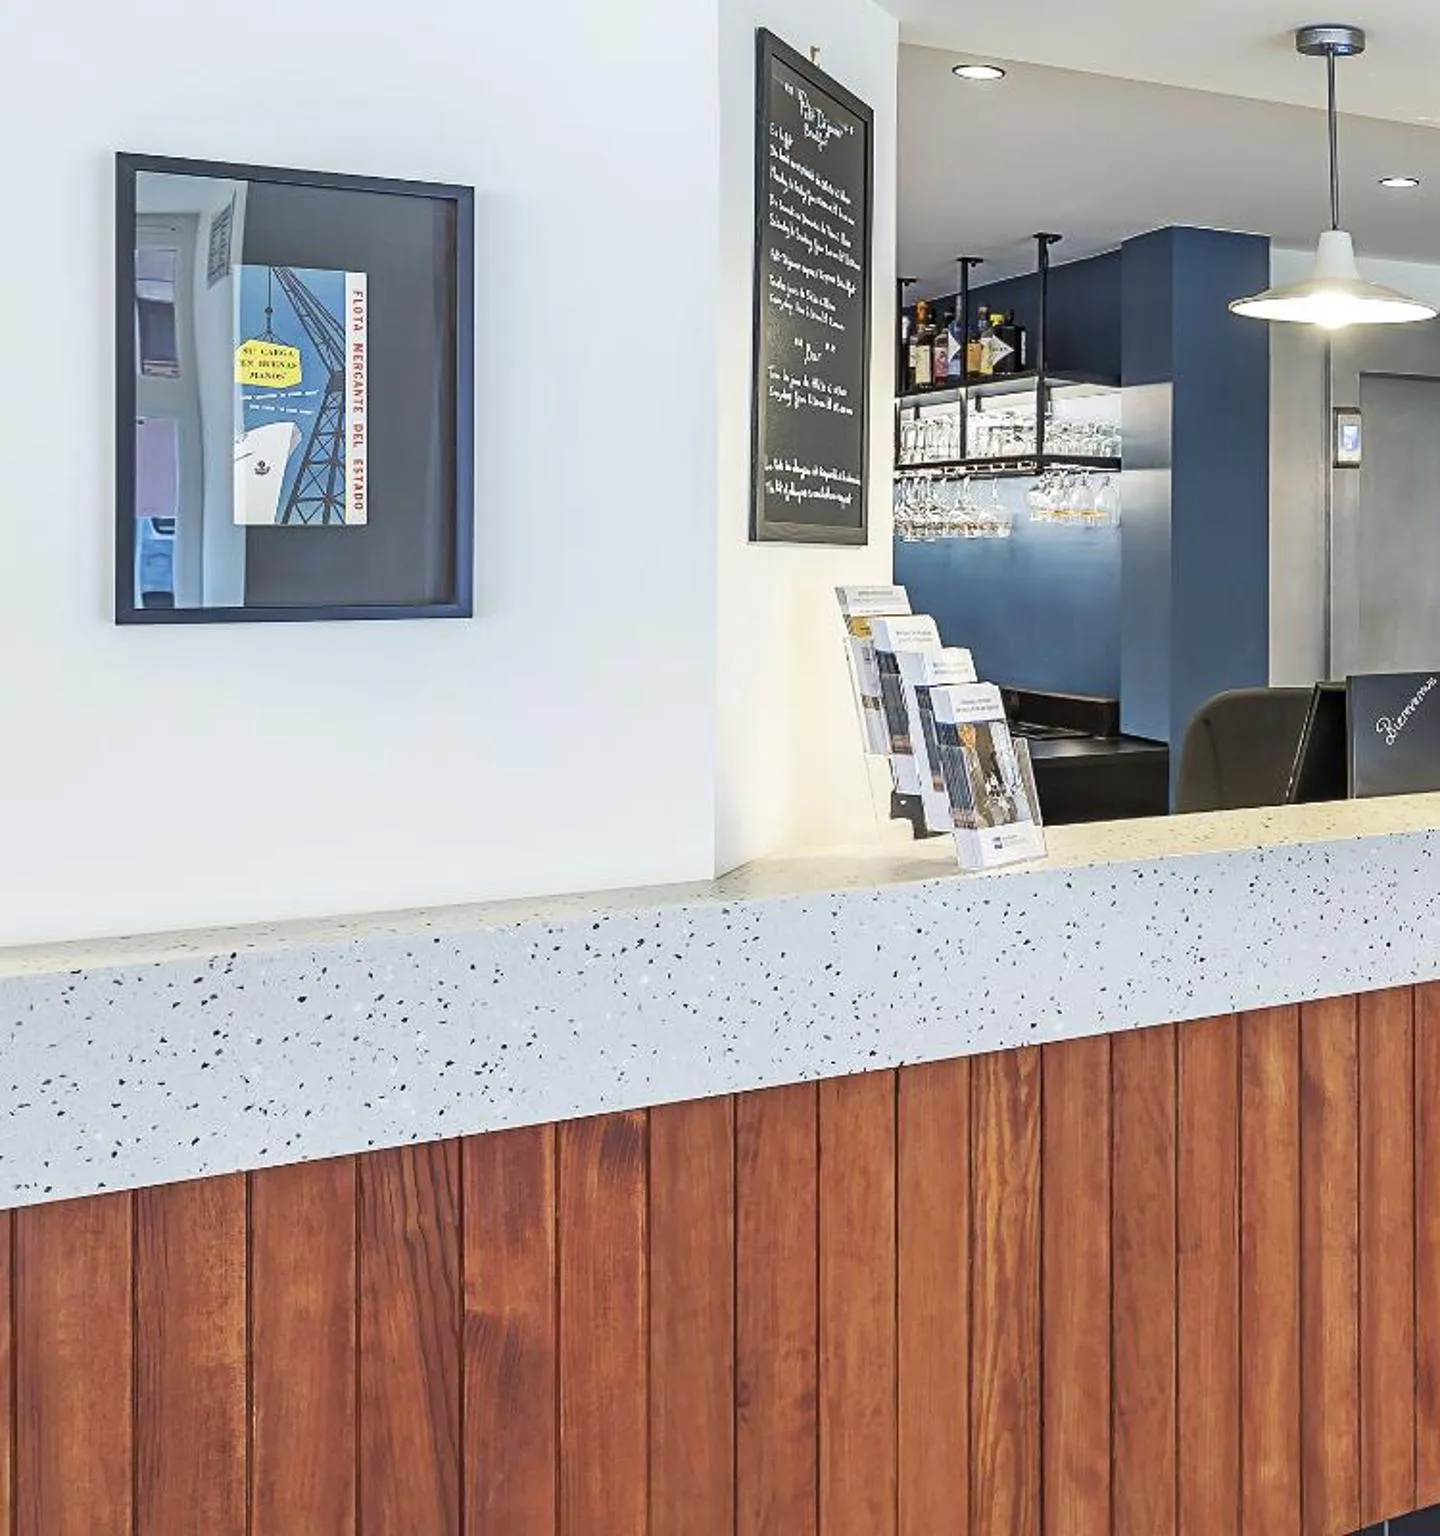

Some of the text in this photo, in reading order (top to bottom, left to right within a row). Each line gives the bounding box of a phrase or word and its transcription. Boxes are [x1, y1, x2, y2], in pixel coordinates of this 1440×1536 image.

[352, 290, 364, 511] FLOTA MERCANTE DEL ESTADO
